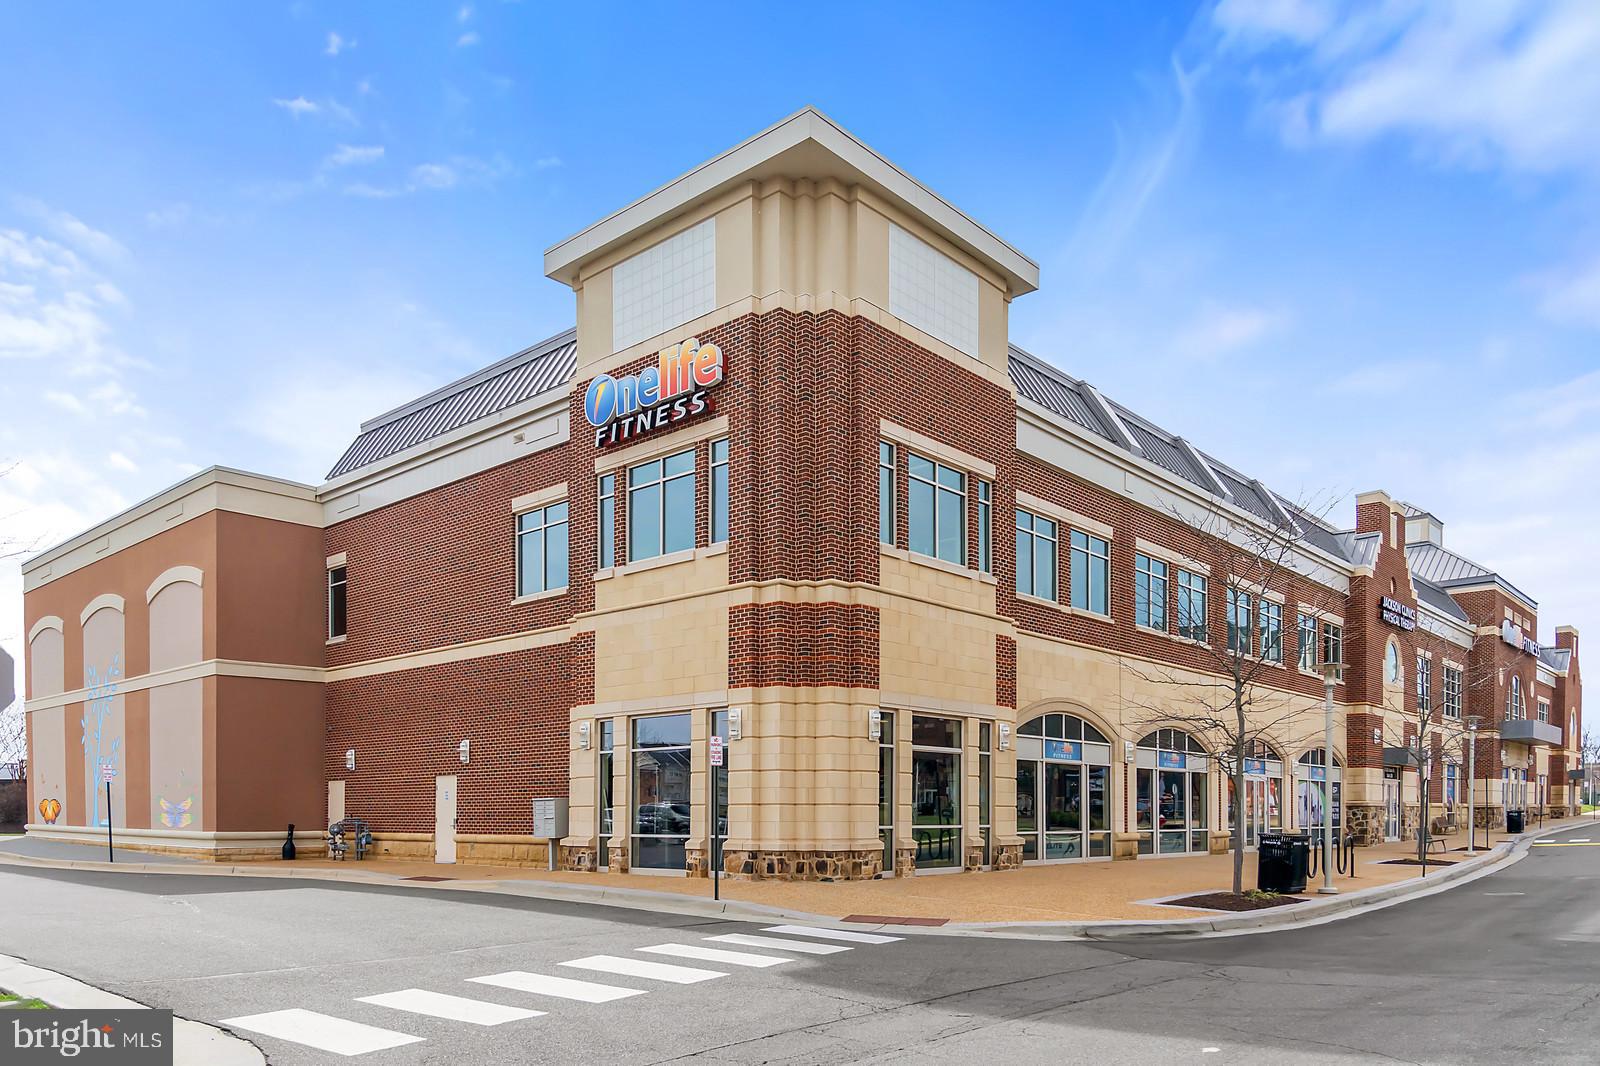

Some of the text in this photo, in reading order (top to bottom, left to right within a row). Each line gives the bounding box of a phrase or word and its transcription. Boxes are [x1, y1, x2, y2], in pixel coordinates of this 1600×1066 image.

[585, 338, 723, 426] Onelife
[595, 391, 706, 448] FITNESS
[1523, 636, 1541, 658] FITNESS
